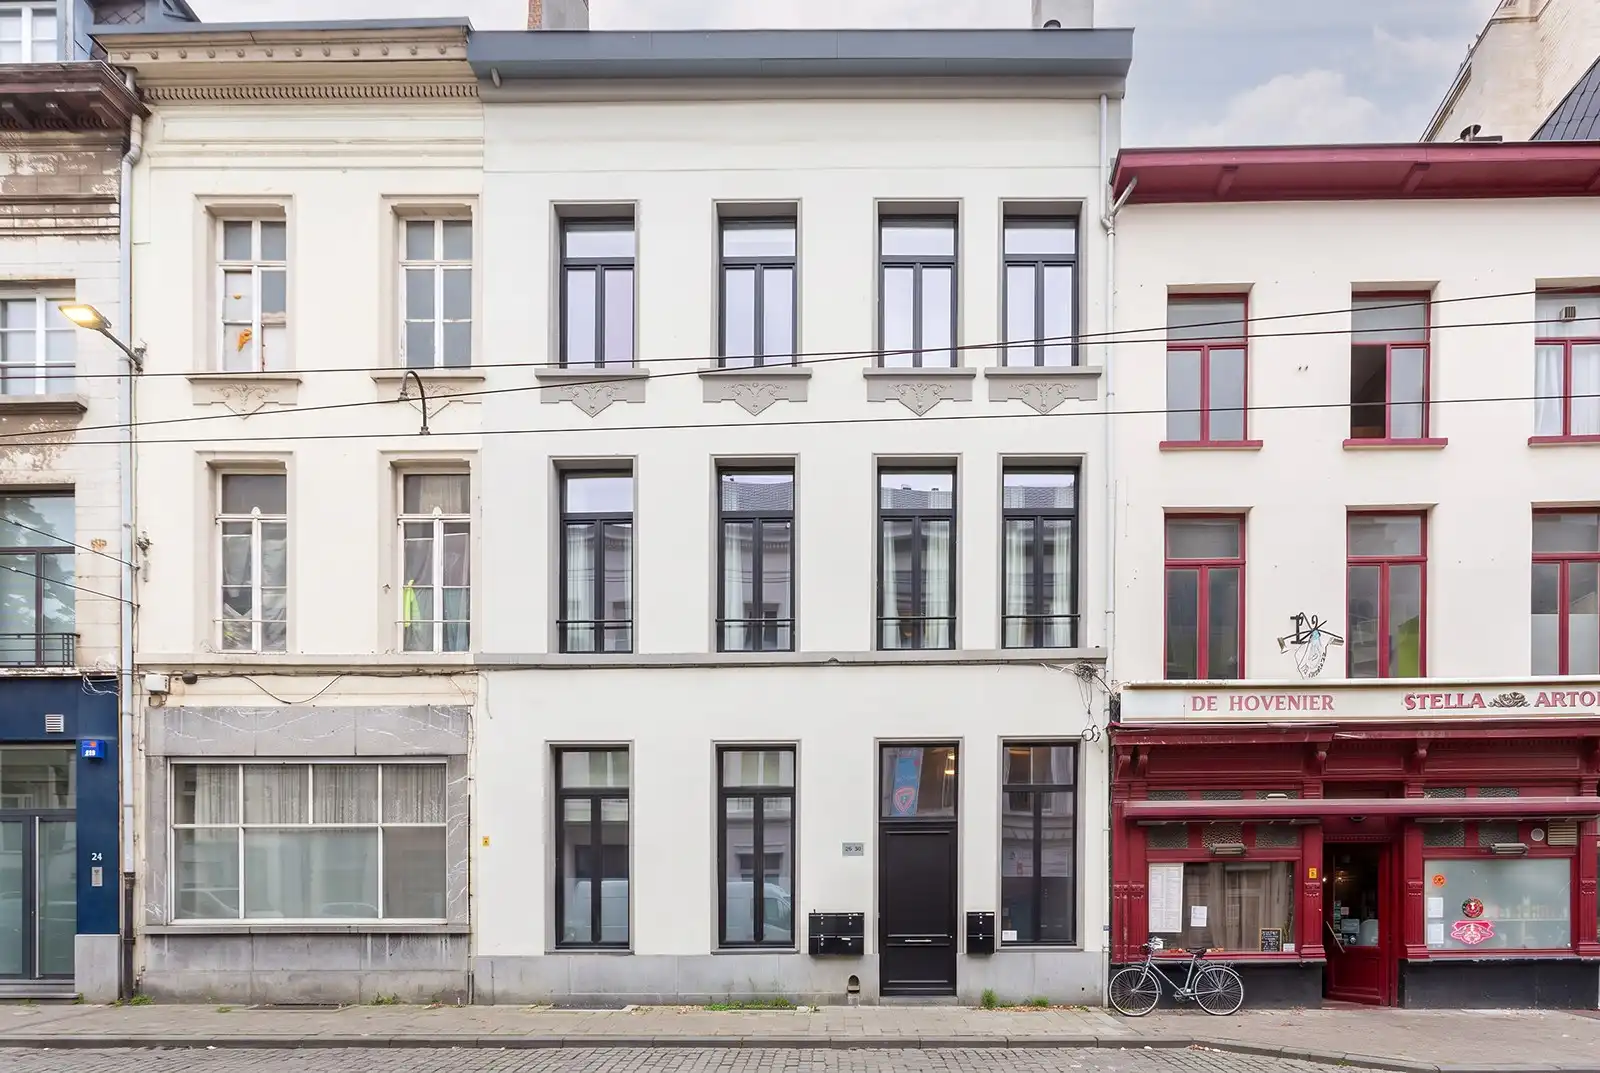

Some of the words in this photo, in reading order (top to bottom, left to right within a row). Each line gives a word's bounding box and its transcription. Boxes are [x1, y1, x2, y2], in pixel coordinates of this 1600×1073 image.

[1191, 695, 1218, 712] DE
[1229, 694, 1335, 711] HOVENIER
[1404, 692, 1487, 711] STELLA
[91, 852, 103, 861] 24
